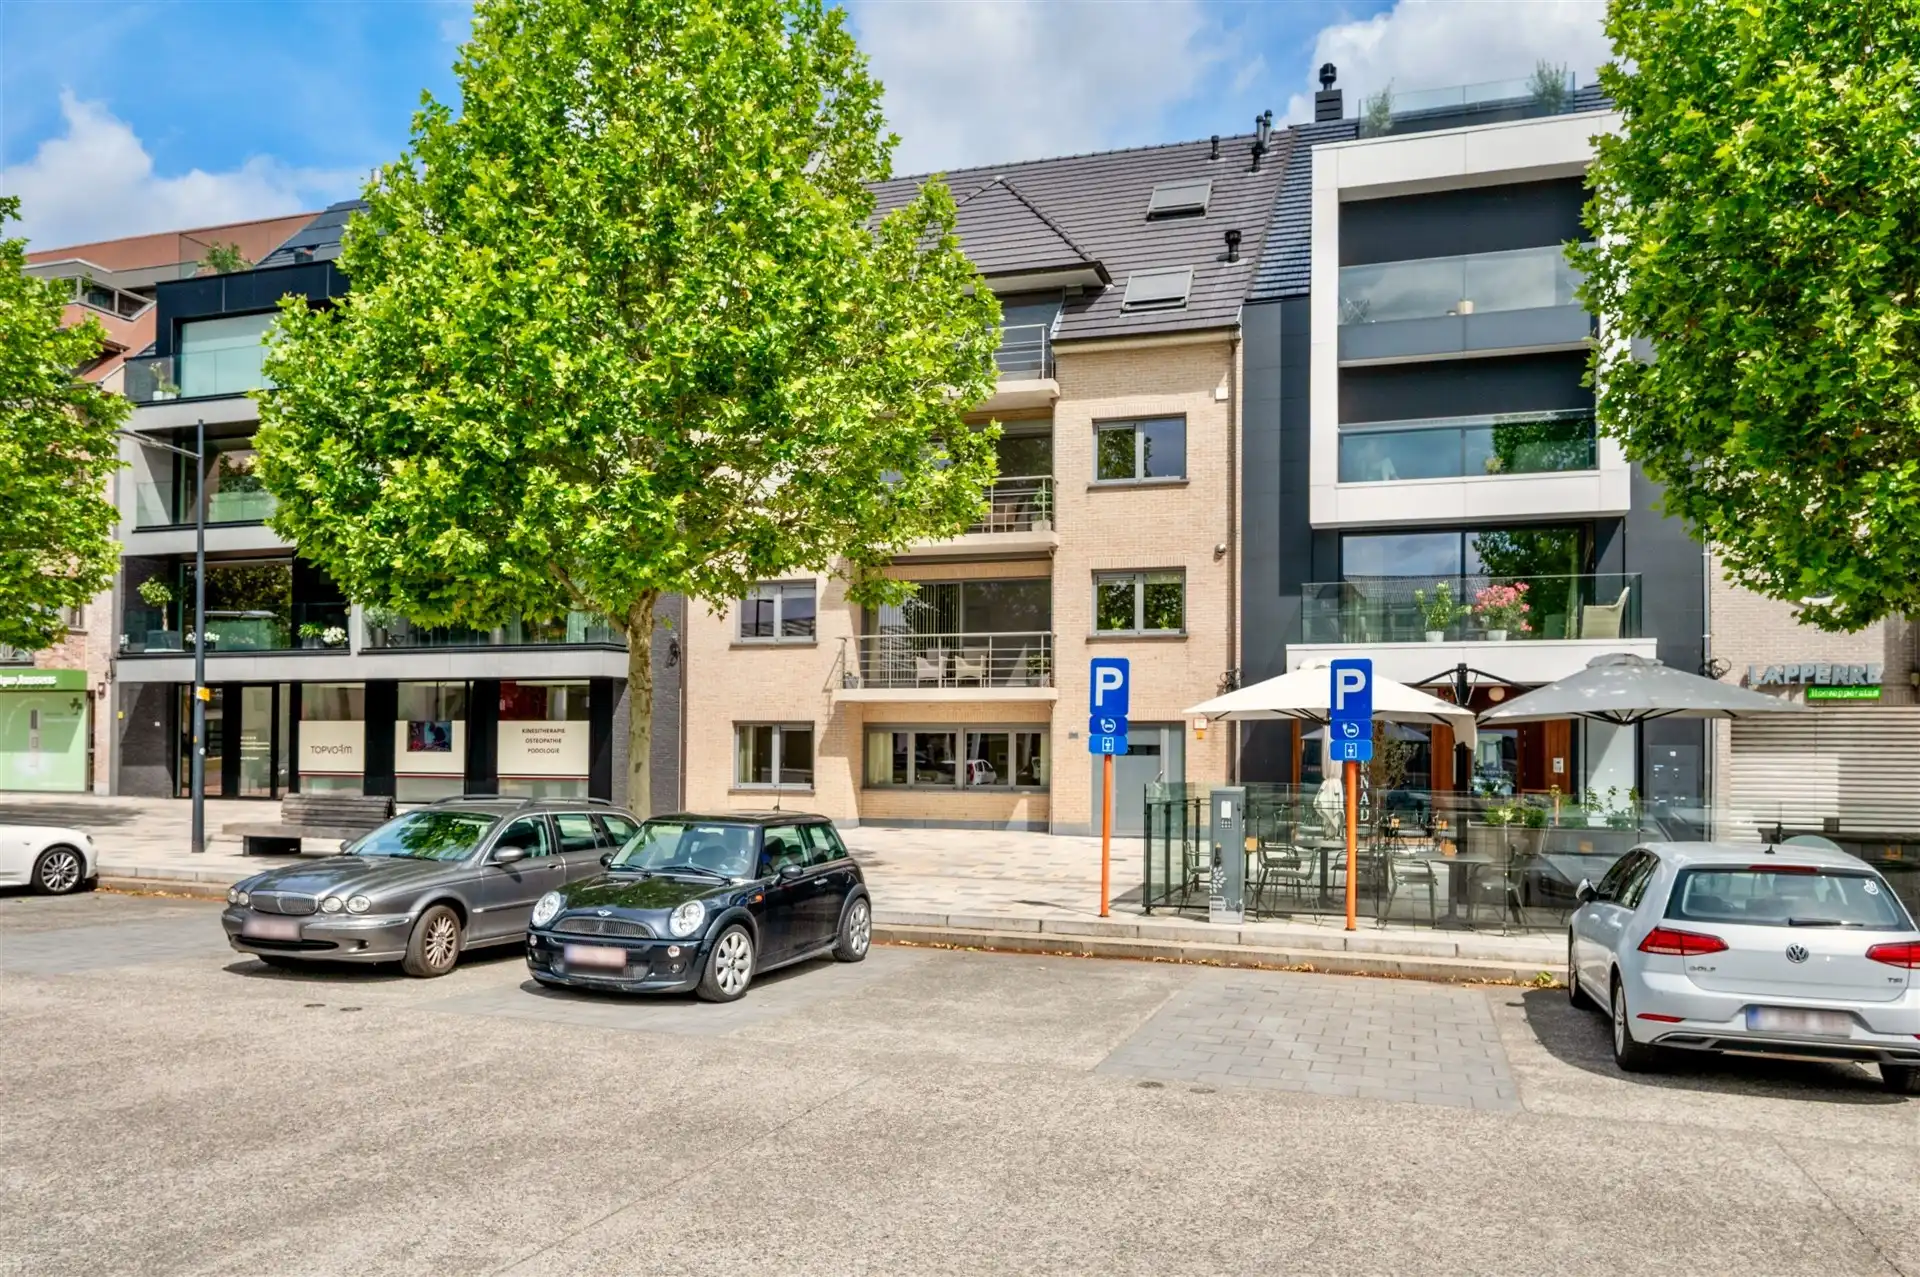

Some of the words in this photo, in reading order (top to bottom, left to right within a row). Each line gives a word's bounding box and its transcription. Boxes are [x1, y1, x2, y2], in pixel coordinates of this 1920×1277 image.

[1095, 667, 1124, 706] P
[1336, 669, 1366, 710] P
[1749, 663, 1883, 685] LAPPERRE
